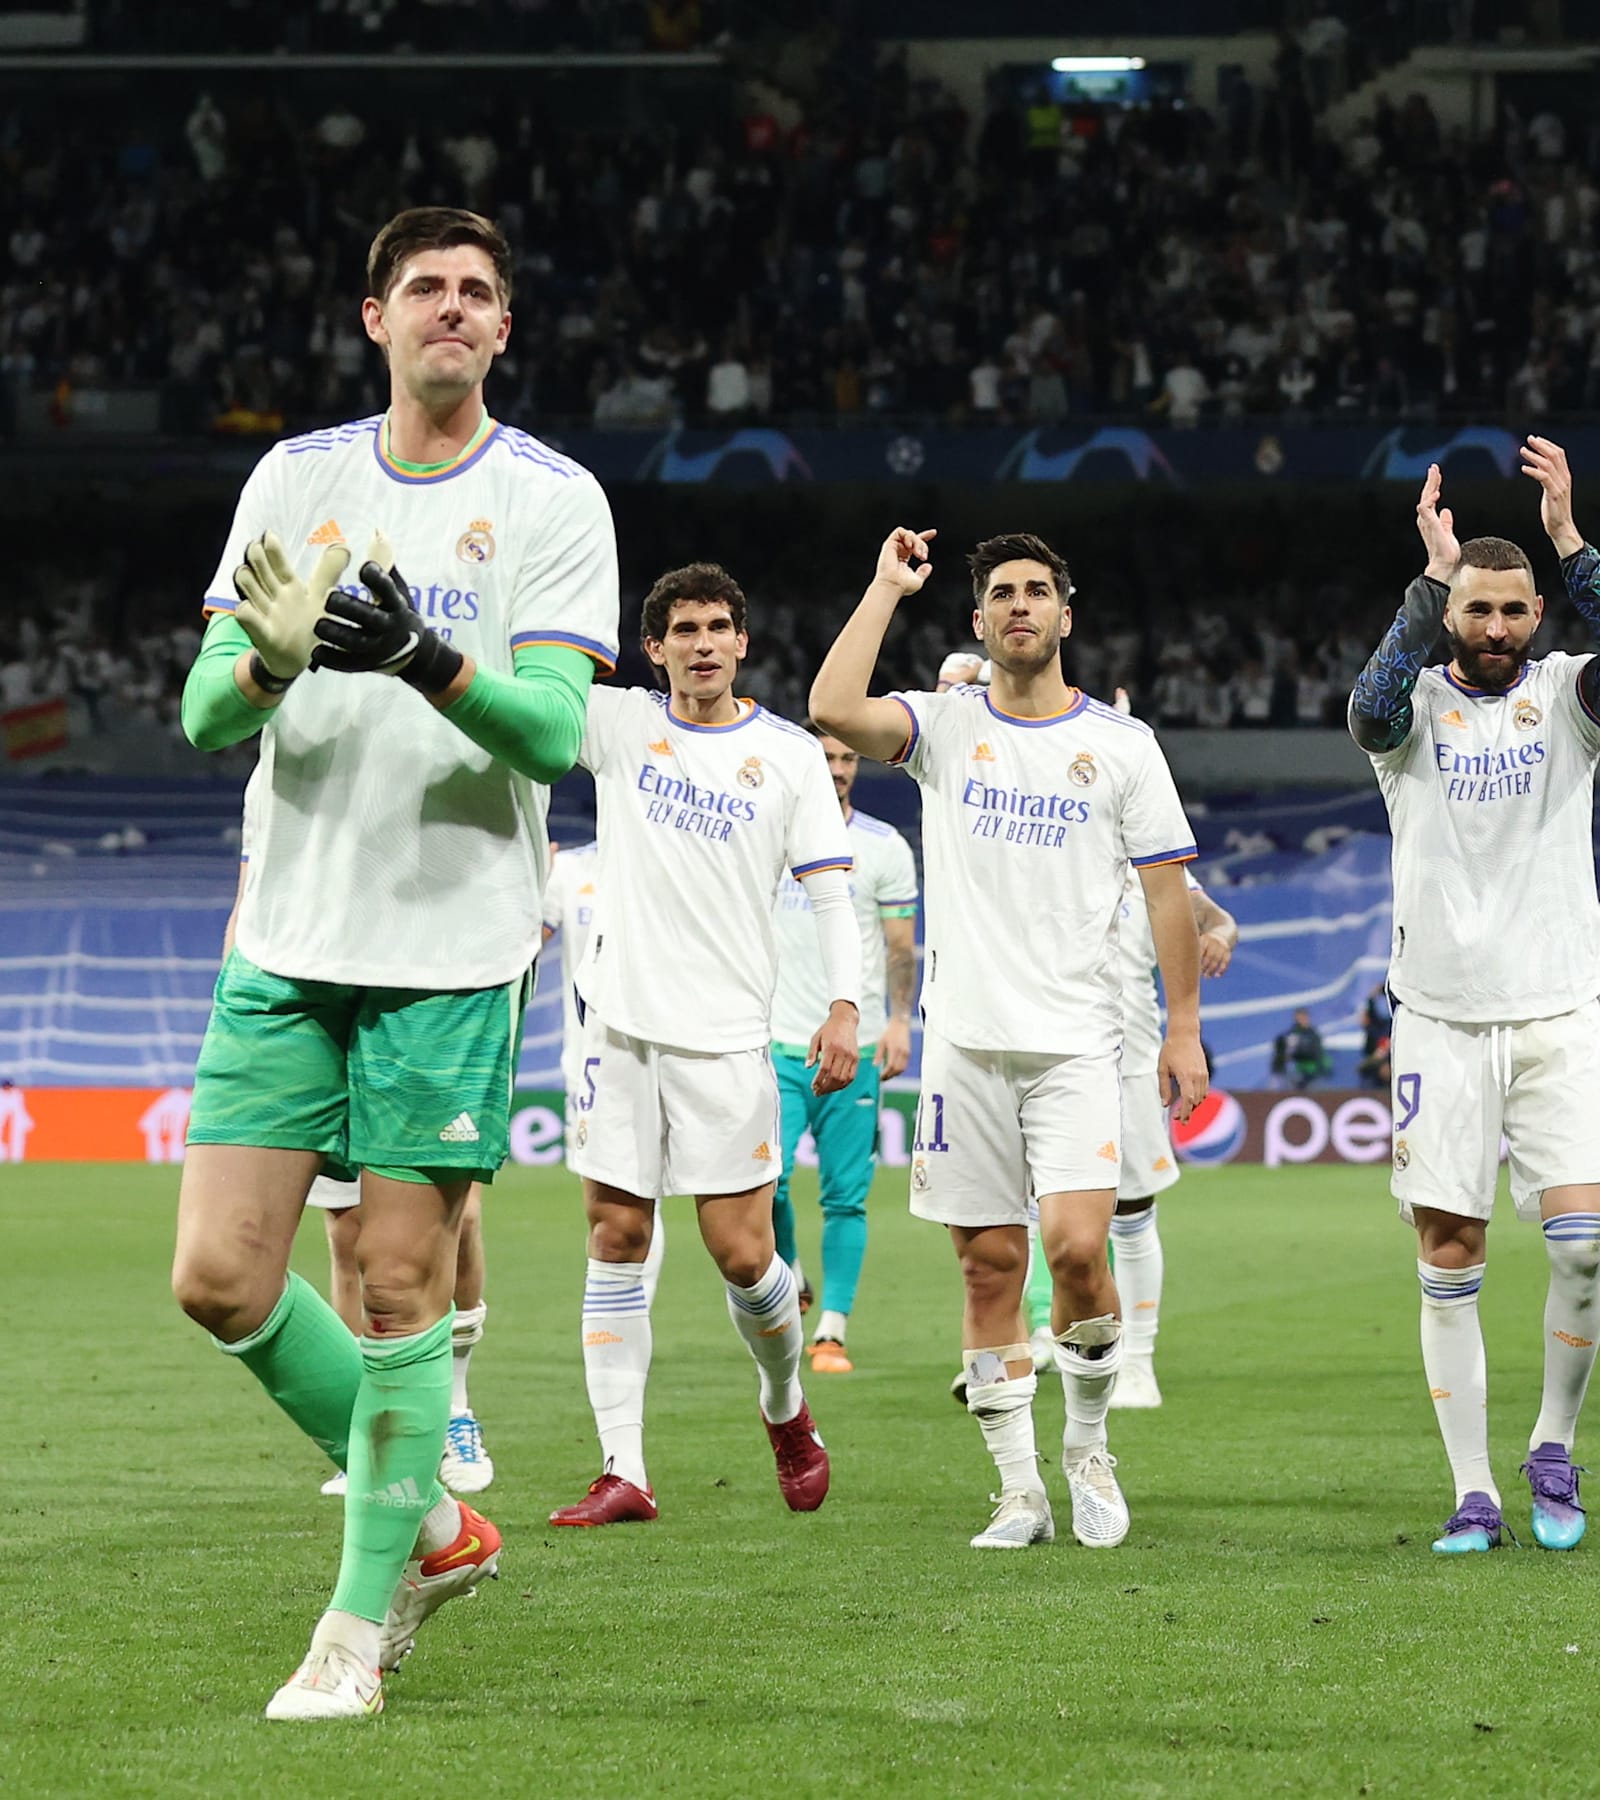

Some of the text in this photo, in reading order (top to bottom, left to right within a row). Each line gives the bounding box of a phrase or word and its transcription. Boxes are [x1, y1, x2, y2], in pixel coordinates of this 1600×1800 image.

[1436, 740, 1546, 778] Emirates
[637, 763, 757, 823] Emirates
[963, 777, 1090, 824] Emirates
[1449, 772, 1532, 802] FLY BETTER
[646, 799, 733, 843] FLY BETTER
[972, 815, 1067, 849] FLY BETTER
[579, 1056, 601, 1112] 5
[1395, 1072, 1421, 1131] 9
